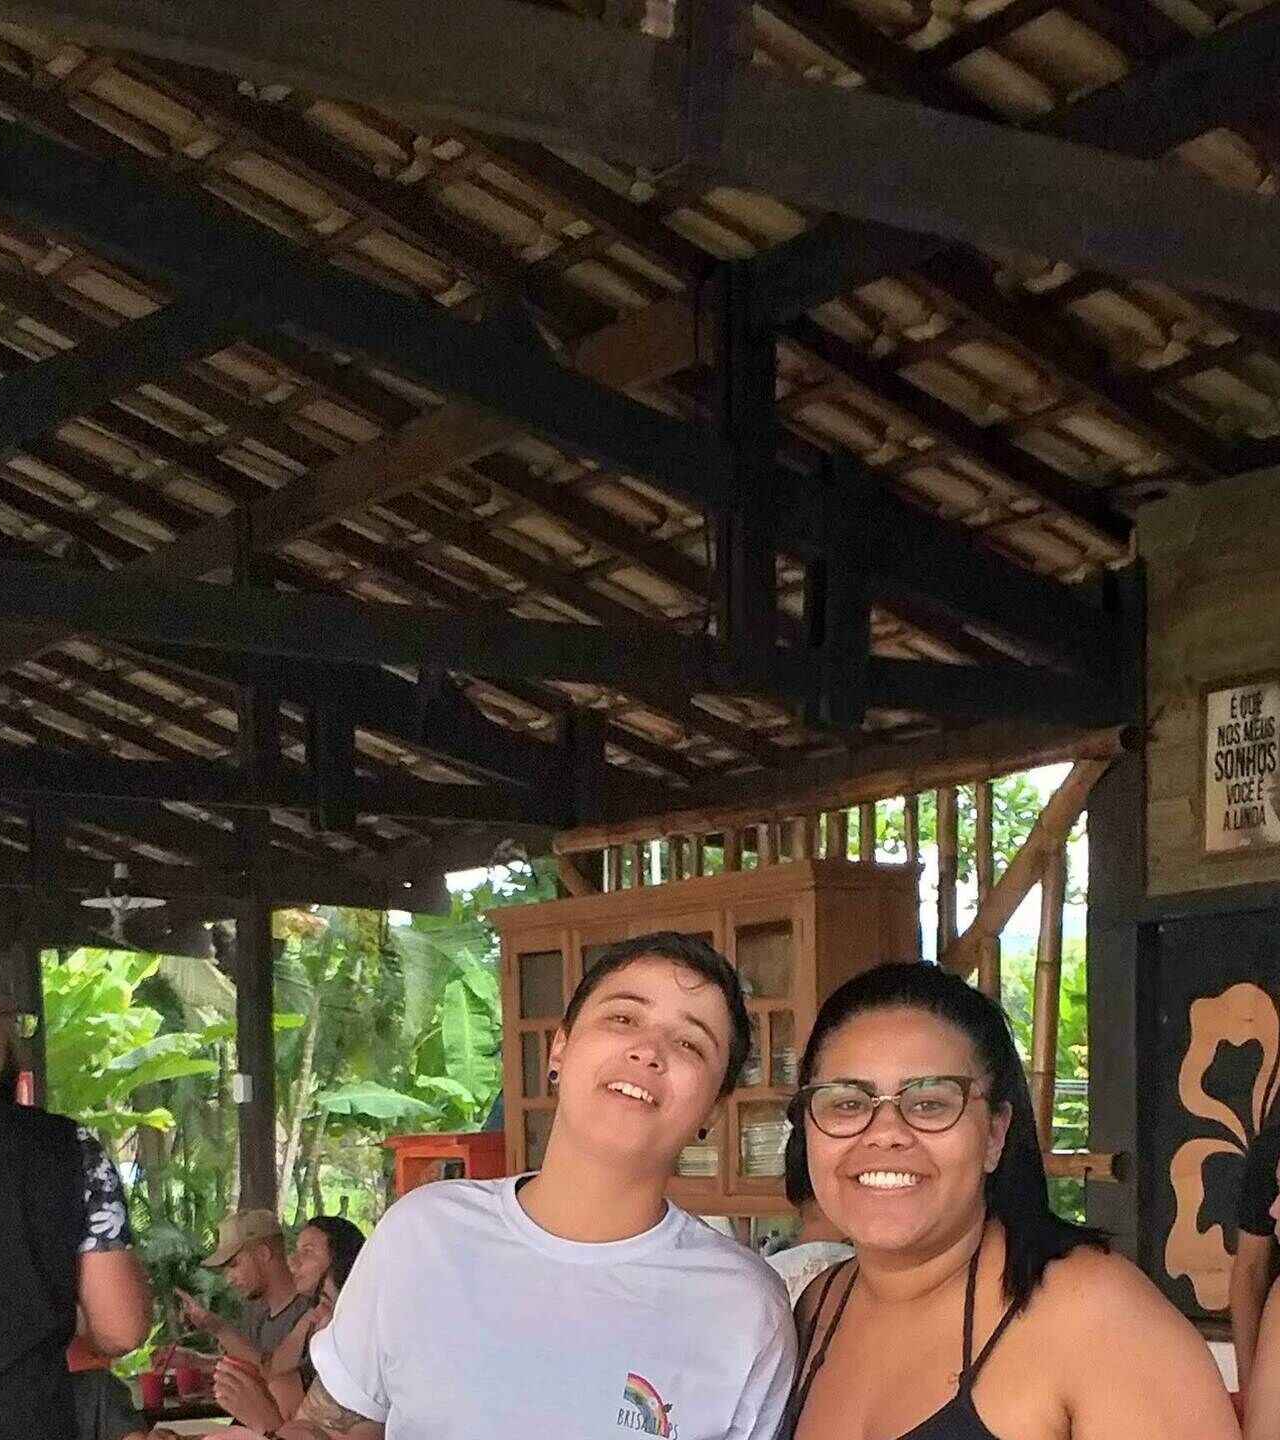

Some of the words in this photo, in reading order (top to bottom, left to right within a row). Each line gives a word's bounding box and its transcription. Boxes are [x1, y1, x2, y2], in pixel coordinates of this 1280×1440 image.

[1240, 691, 1263, 718] QUE
[1218, 722, 1241, 746] NOS
[1243, 716, 1276, 742] MEUS
[1214, 742, 1277, 782] SONHOS
[1223, 810, 1231, 832] A
[1234, 805, 1267, 831] LINDA
